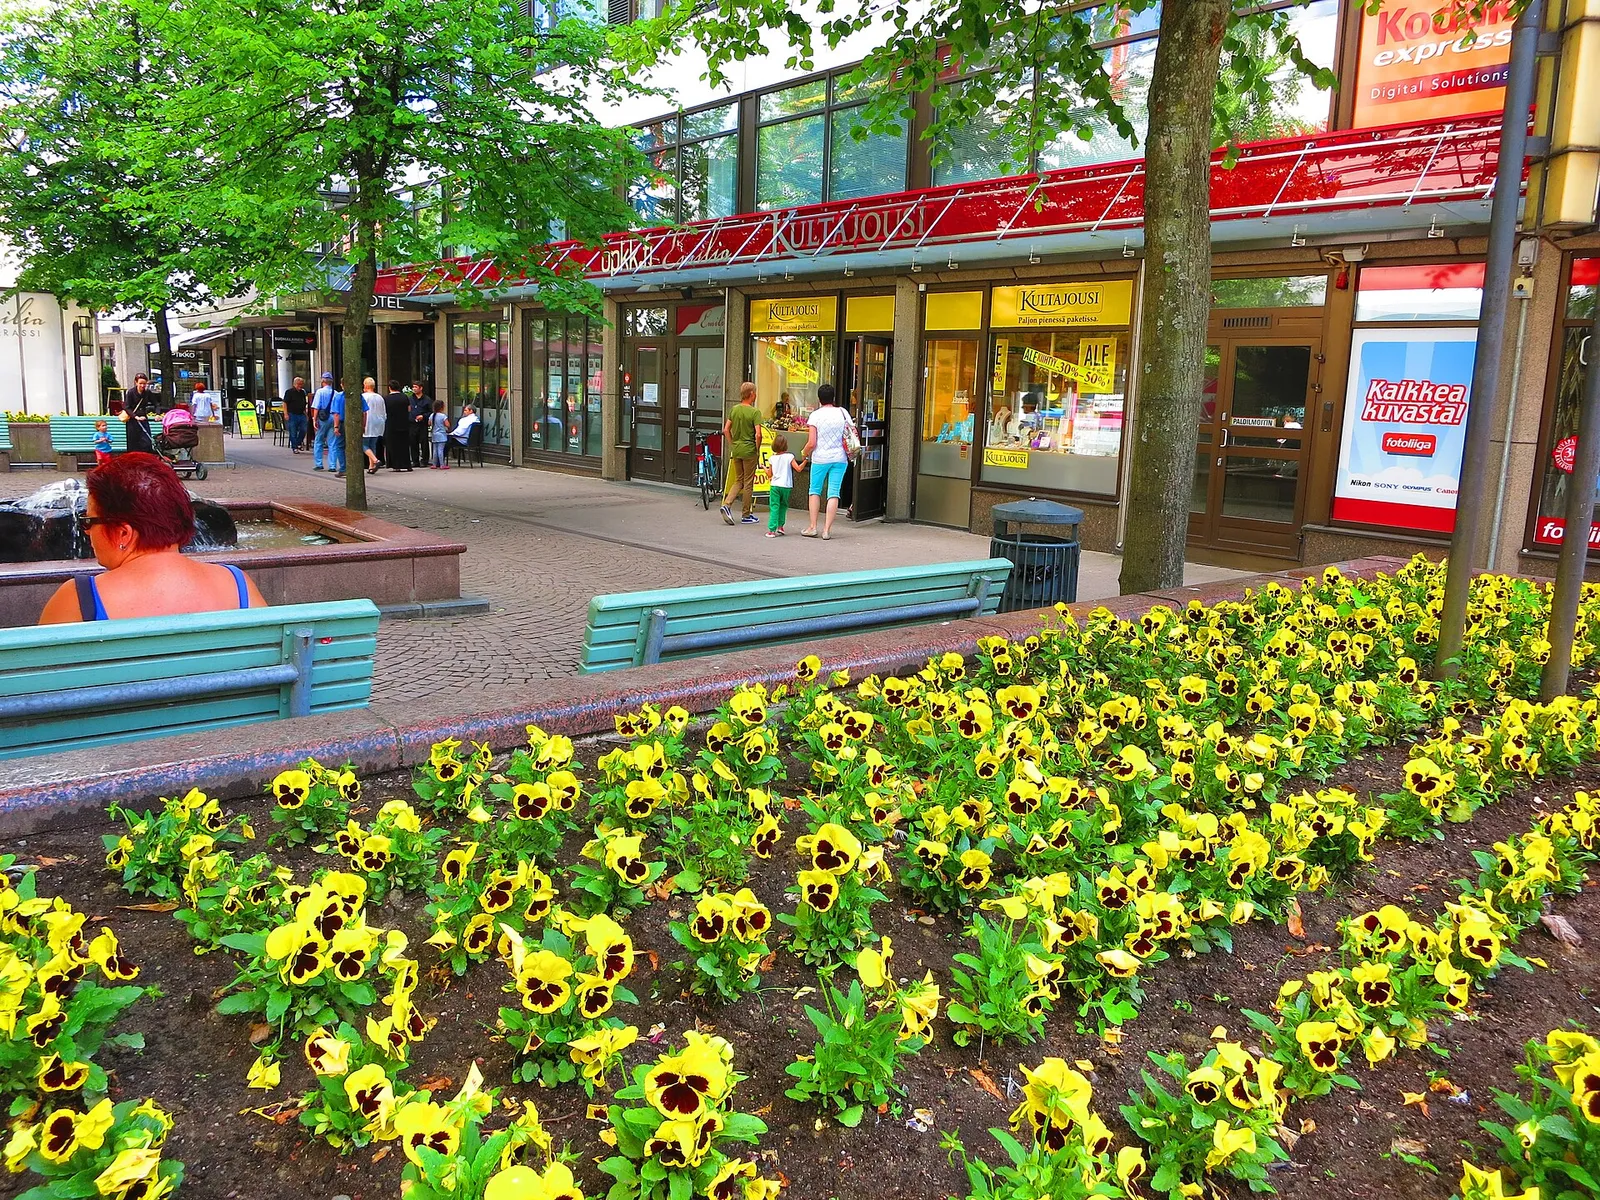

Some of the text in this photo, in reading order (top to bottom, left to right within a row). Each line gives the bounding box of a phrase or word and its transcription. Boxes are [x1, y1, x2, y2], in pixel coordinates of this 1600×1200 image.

[1373, 29, 1513, 67] express
[1371, 69, 1510, 100] Digital Solutions
[770, 205, 927, 259] KULTAJOUSI
[369, 295, 404, 309] OTEL
[1020, 290, 1100, 313] KULTAJOUSI
[768, 303, 818, 321] KULTAJOUSI
[1018, 314, 1099, 325] Paljon pienessä paketissa.
[0, 329, 41, 337] RASSI
[791, 345, 806, 362] ALE
[1023, 348, 1038, 363] ALE
[1083, 344, 1110, 366] ALE
[1367, 380, 1466, 403] Kaikkea
[1362, 400, 1467, 424] kuvasta!
[1386, 437, 1432, 450] fotoliiga
[985, 451, 1026, 465] KULTAJOUSI
[1350, 479, 1372, 487] Nikon
[1374, 482, 1399, 490] SONY
[1402, 484, 1432, 492] OLYMPUS
